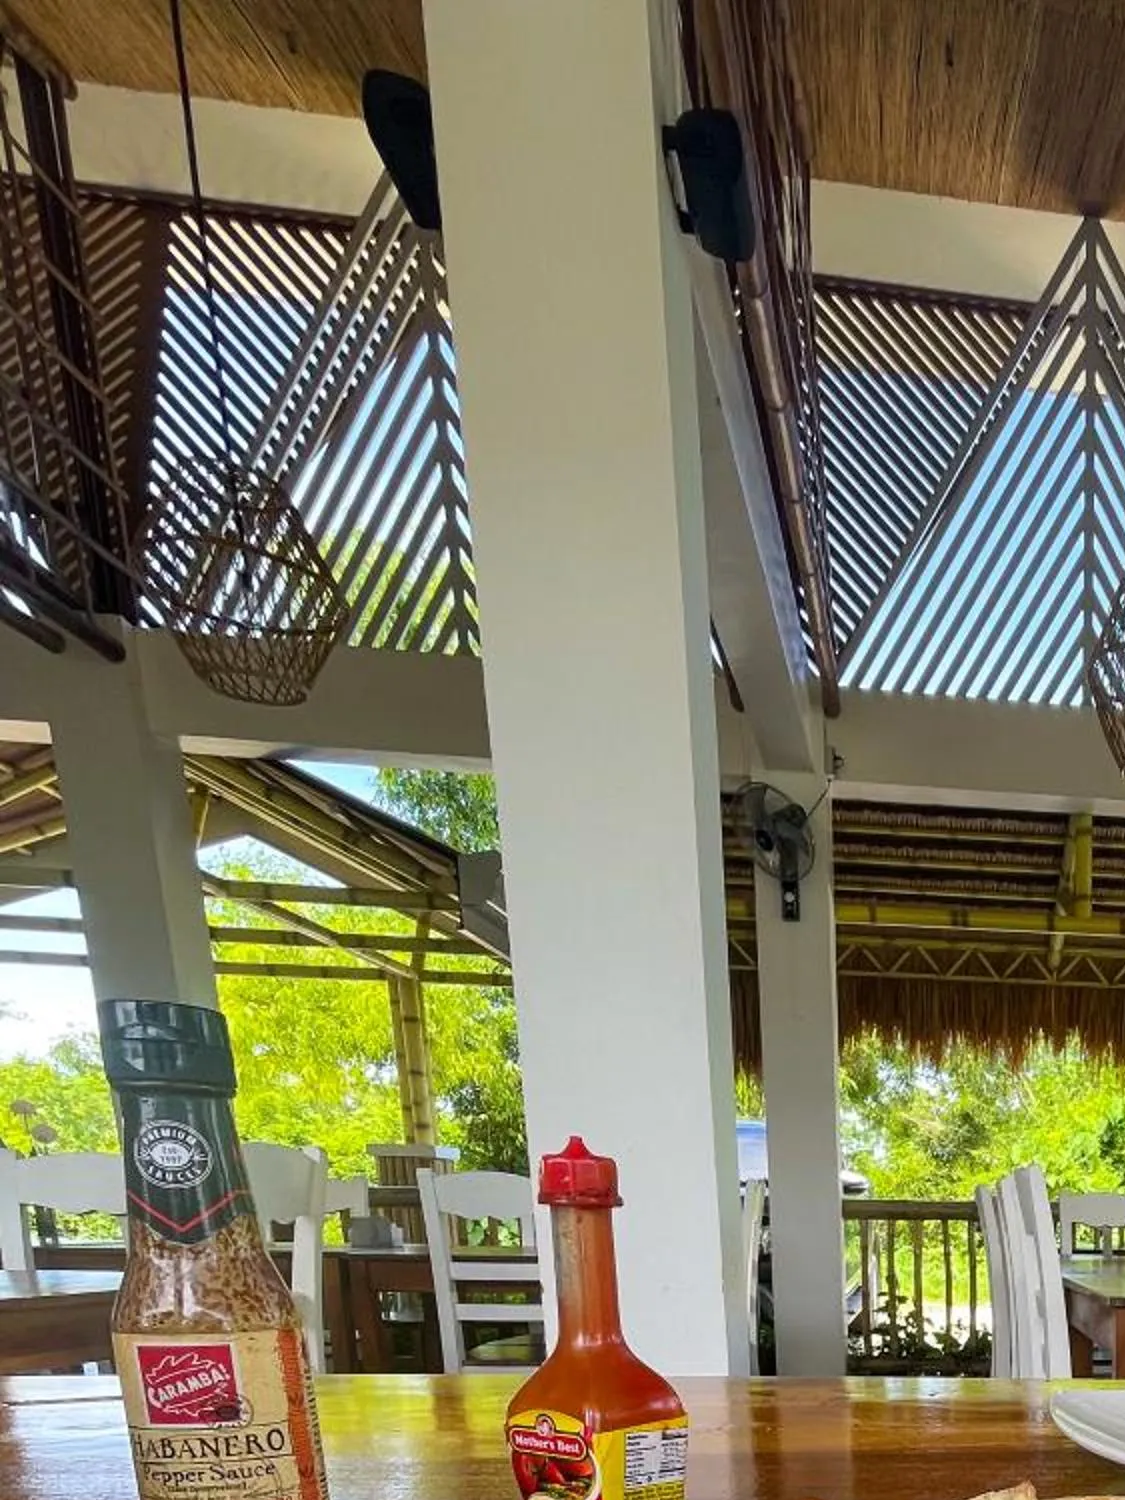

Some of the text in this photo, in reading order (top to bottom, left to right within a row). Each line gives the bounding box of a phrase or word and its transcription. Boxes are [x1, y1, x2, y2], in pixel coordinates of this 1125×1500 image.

[147, 1363, 231, 1409] CARAMBA!
[514, 1434, 580, 1455] Mother's Best
[144, 1462, 276, 1487] Pepper Sauce
